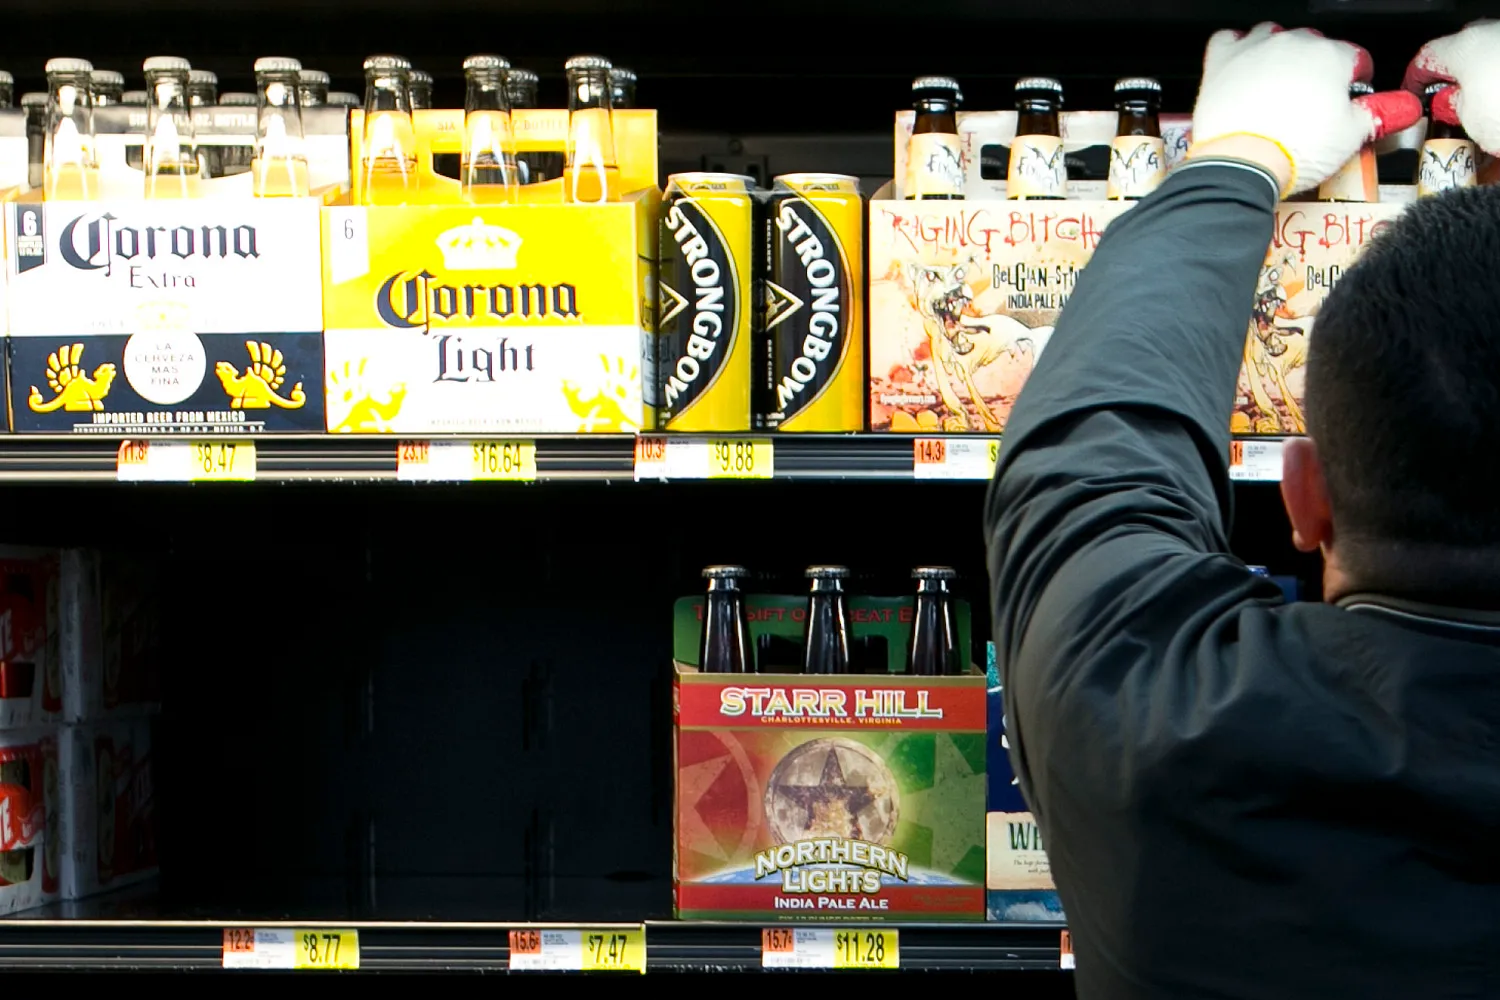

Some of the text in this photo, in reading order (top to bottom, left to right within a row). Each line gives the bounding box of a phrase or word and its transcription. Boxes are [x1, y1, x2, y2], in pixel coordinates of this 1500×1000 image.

[22, 211, 37, 236] 6
[1004, 211, 1103, 249] BITCH
[60, 212, 260, 276] Corona
[129, 265, 197, 289] Extra
[377, 268, 582, 336] Corona
[664, 206, 724, 408] STRONGBOW
[775, 206, 840, 410] STRONGBOW
[1008, 294, 1032, 308] INDIA
[1035, 294, 1056, 308] PALE
[432, 335, 535, 383] Light
[93, 411, 245, 424] IMPORTED BEER FROM MEXICO
[198, 443, 236, 473] $8.47
[473, 443, 521, 473] $16.64
[716, 442, 754, 471] $9.88
[720, 687, 943, 719] STARR HILL
[858, 716, 902, 724] VIRGINIA
[755, 838, 908, 881] NORTHERN
[782, 867, 881, 894] LIGHTS
[774, 897, 888, 910] INDIA PALE ALE
[303, 933, 341, 964] $8.77
[589, 934, 627, 964] $7.47
[836, 934, 885, 964] $11.28
